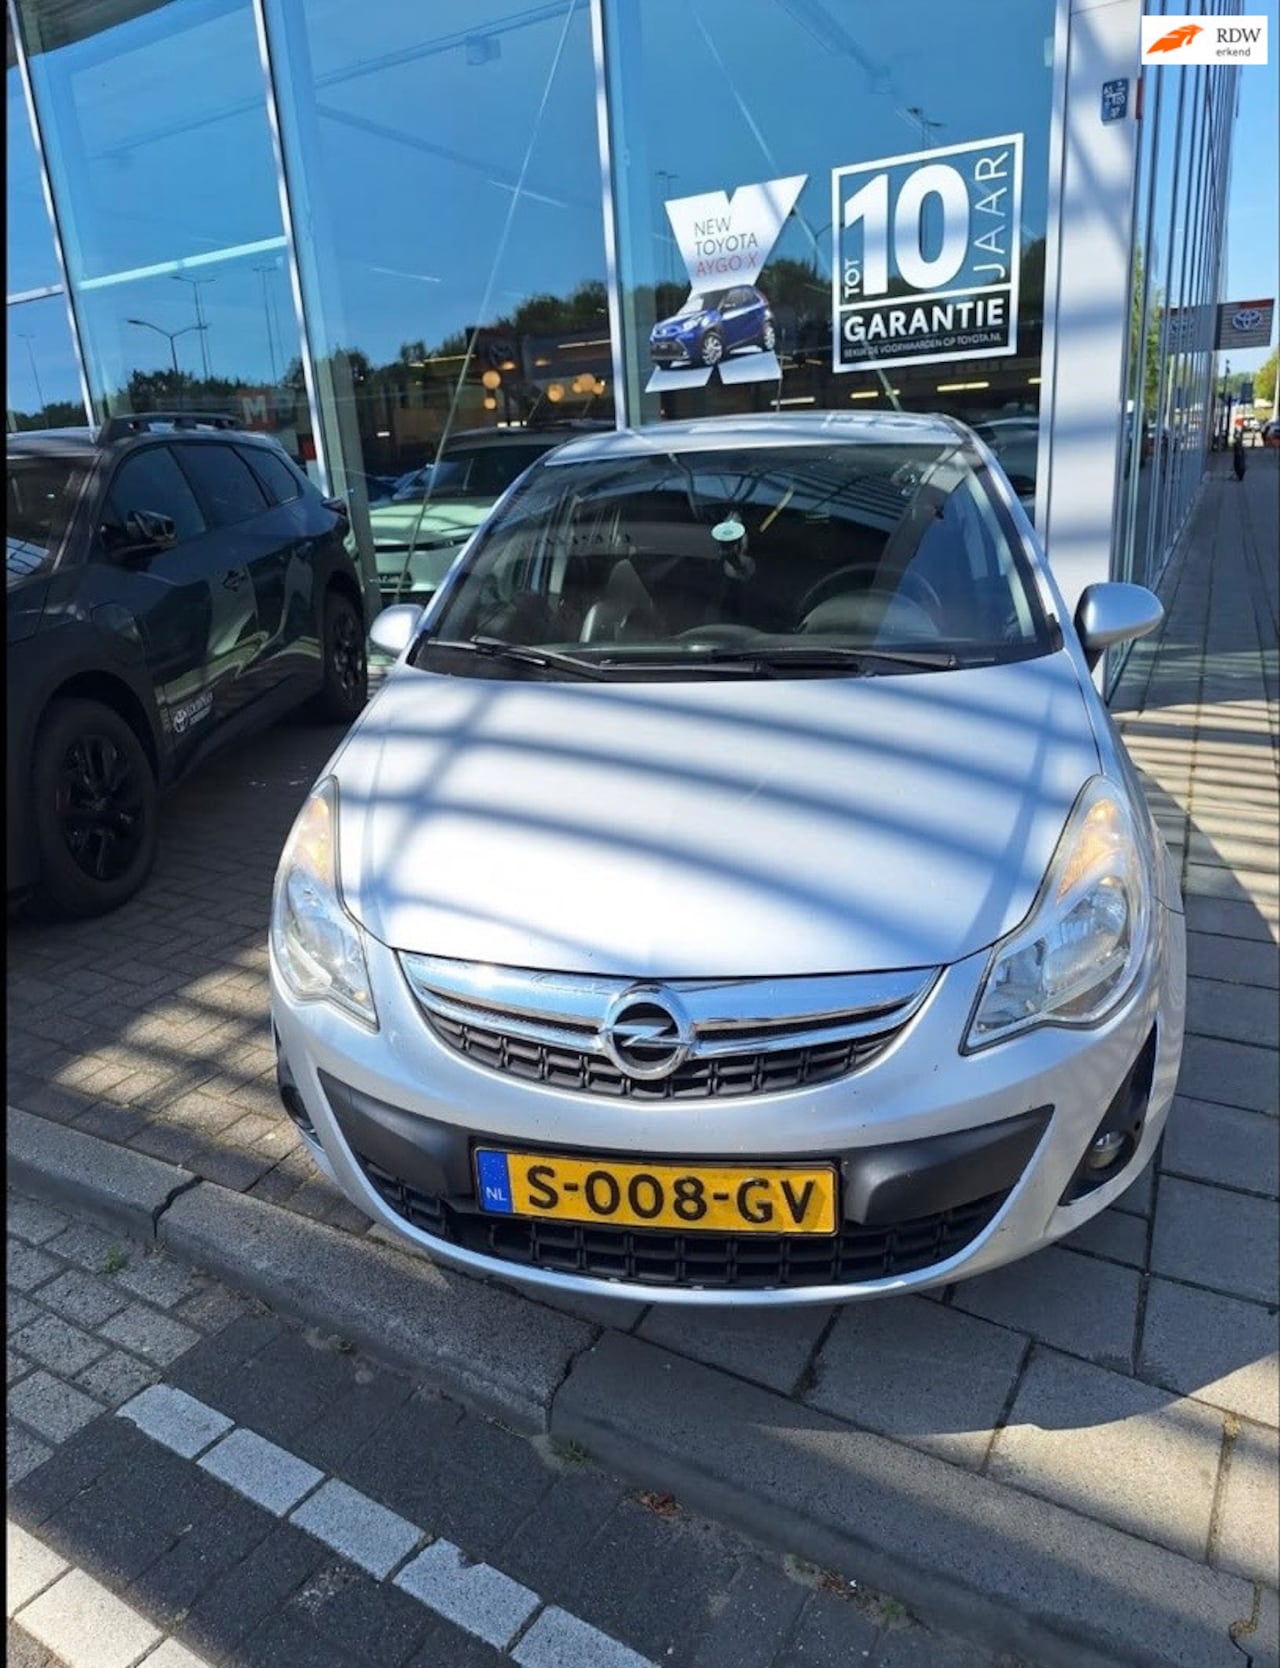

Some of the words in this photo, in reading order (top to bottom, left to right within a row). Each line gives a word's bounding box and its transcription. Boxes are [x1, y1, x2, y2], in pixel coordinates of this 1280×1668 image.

[695, 216, 731, 237] NEW
[844, 164, 969, 295] 10
[973, 151, 1008, 279] JAAR
[696, 232, 758, 256] TOYOTA
[696, 255, 742, 277] AYGO
[747, 251, 758, 270] X
[844, 258, 860, 299] TOT
[844, 298, 1004, 342] GARANTIE
[943, 336, 956, 347] OP
[957, 332, 1002, 345] TOYOTA.NL
[486, 1187, 507, 1201] NL
[527, 1164, 815, 1224] S-008-GV
